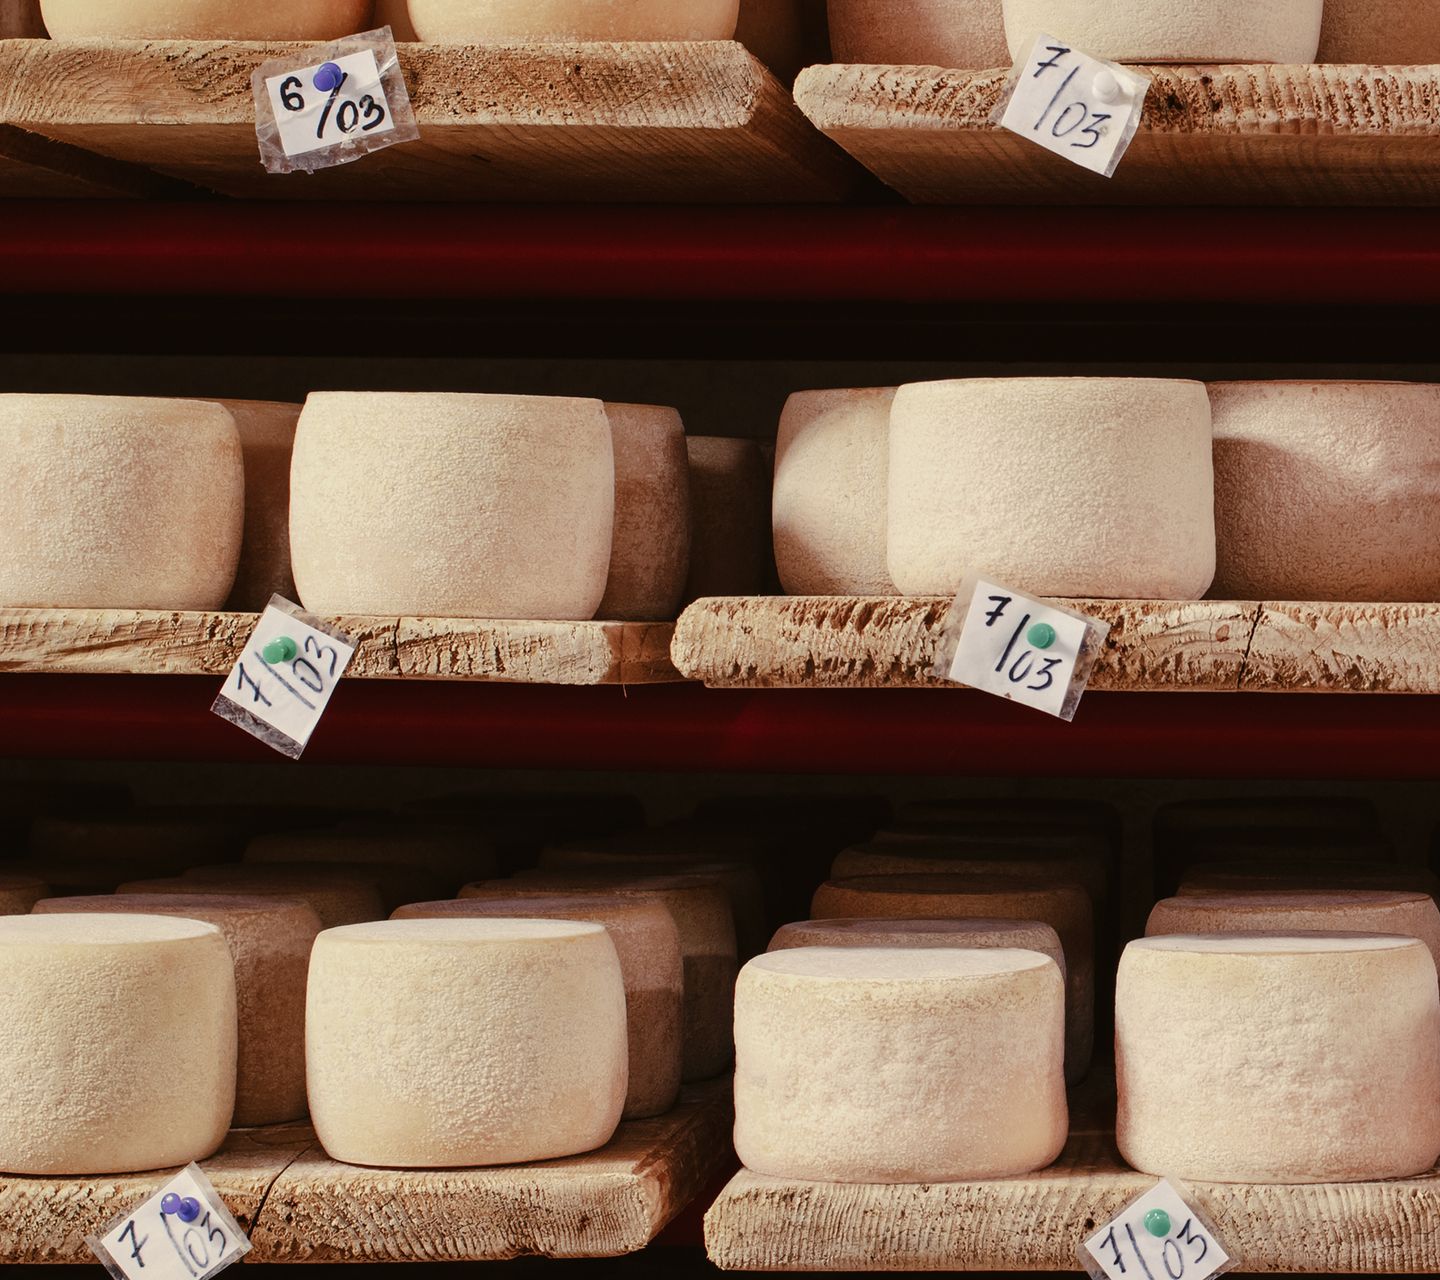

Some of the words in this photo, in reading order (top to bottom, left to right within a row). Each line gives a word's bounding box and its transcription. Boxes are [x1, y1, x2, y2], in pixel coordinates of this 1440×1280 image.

[1033, 46, 1112, 148] 7/03
[237, 635, 338, 711] 7/03
[985, 595, 1063, 691] 7/03
[117, 1210, 227, 1278] 7/03
[1099, 1218, 1208, 1280] 7/03
